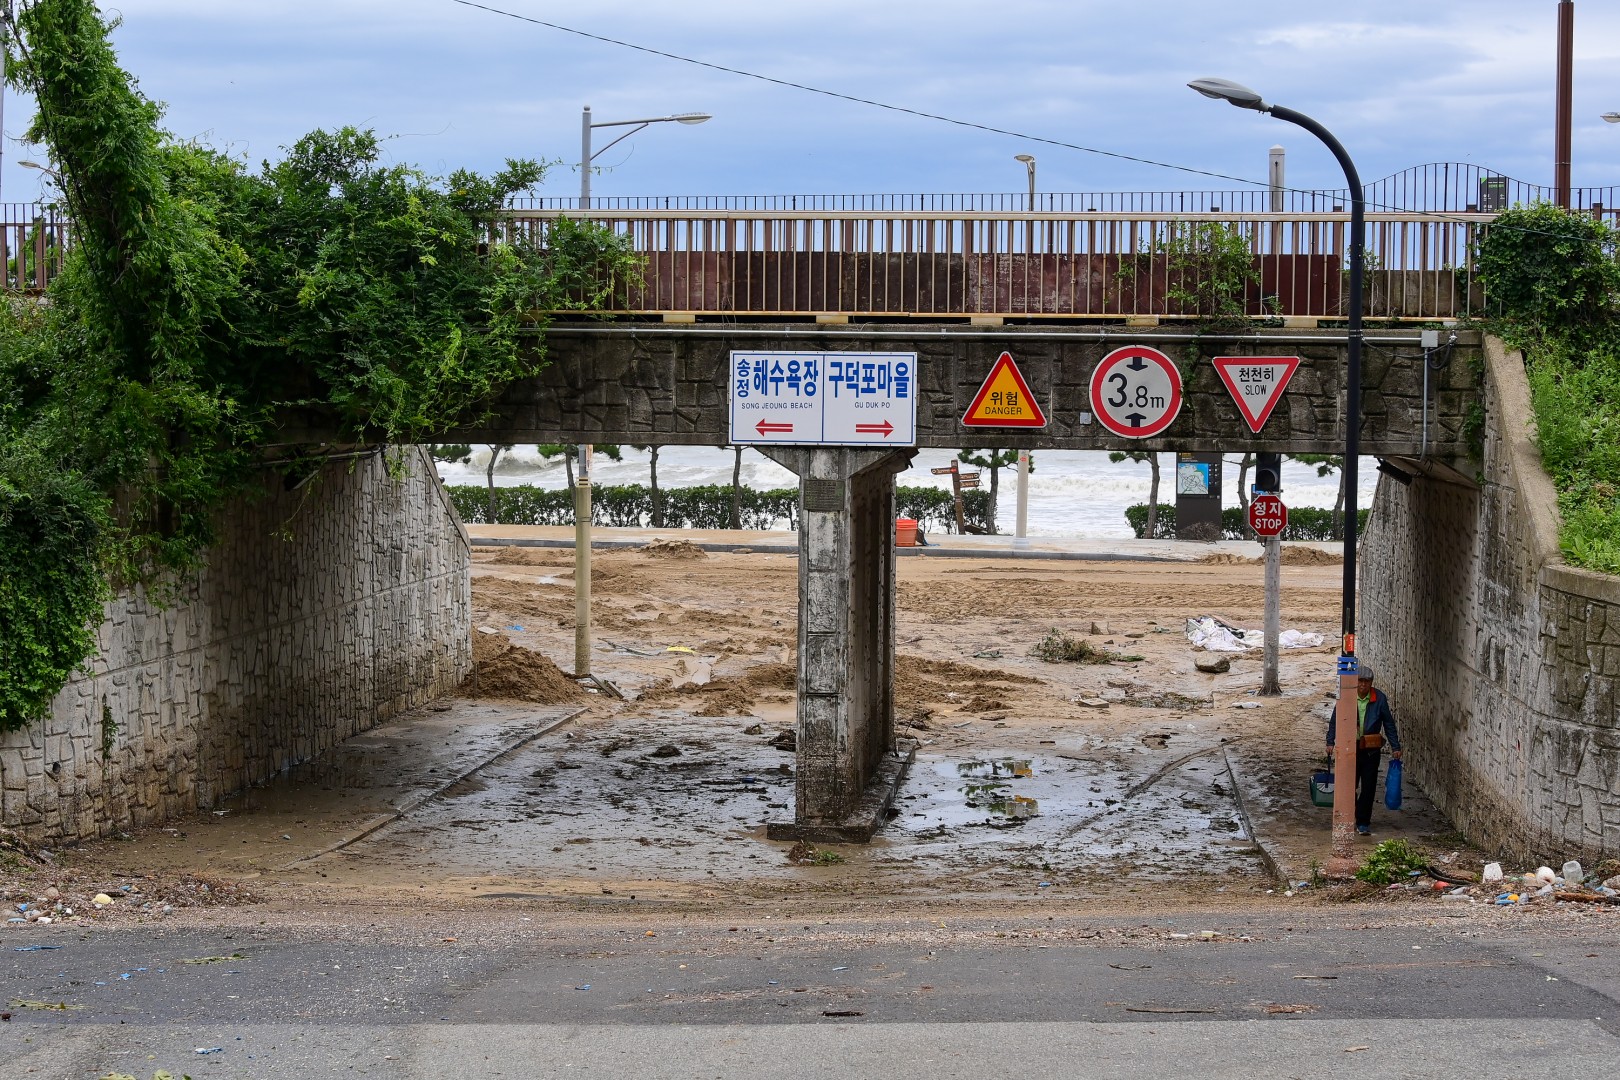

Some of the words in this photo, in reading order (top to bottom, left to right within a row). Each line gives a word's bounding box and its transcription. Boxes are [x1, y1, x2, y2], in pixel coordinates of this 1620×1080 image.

[736, 358, 751, 398] 송정
[753, 359, 819, 397] 해수욕장
[829, 361, 909, 398] 구덕포마을
[1239, 367, 1274, 383] 천천히
[990, 391, 1019, 406] 위험
[1108, 373, 1164, 408] 3.8m
[1245, 385, 1267, 396] SLOW
[985, 406, 1022, 415] DANGER
[1254, 501, 1282, 517] 정지
[1255, 518, 1282, 530] STOP
